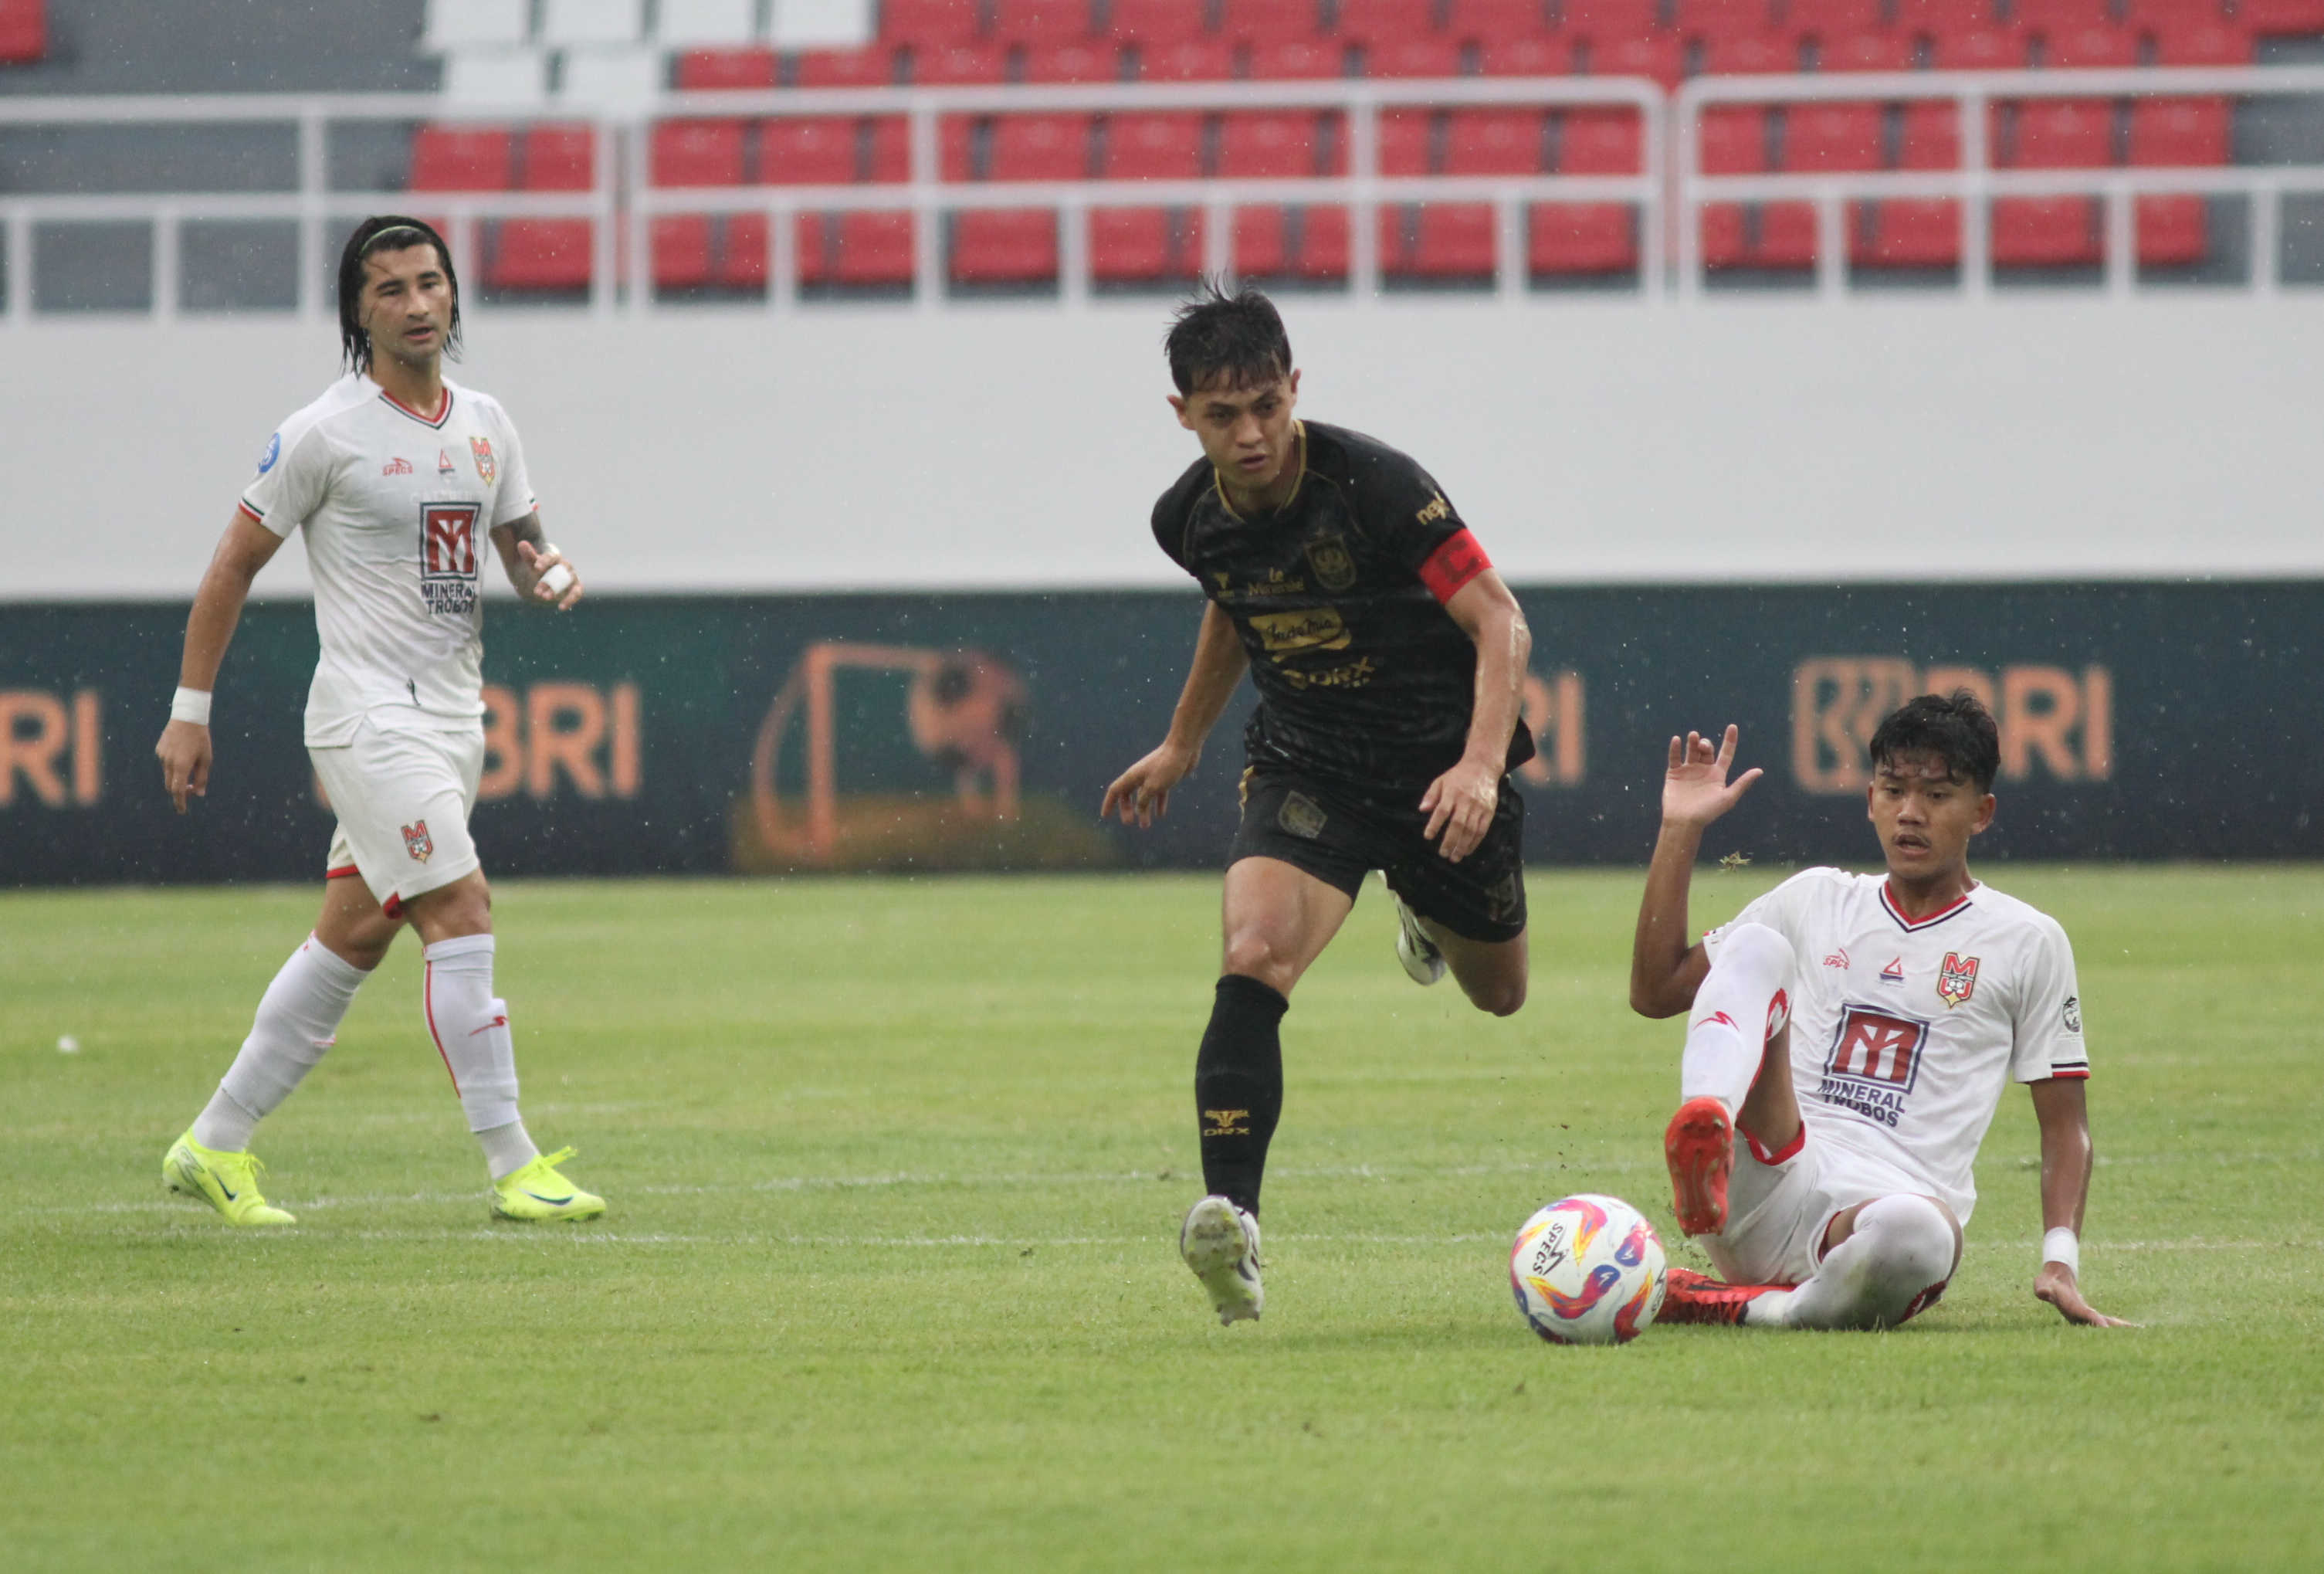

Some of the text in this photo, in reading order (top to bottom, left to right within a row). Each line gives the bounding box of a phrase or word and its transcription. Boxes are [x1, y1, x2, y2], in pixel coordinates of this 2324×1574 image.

[1926, 664, 2112, 782] RI
[1817, 1079, 1906, 1114] MINERAL
[1533, 1223, 1563, 1275] SPECS
